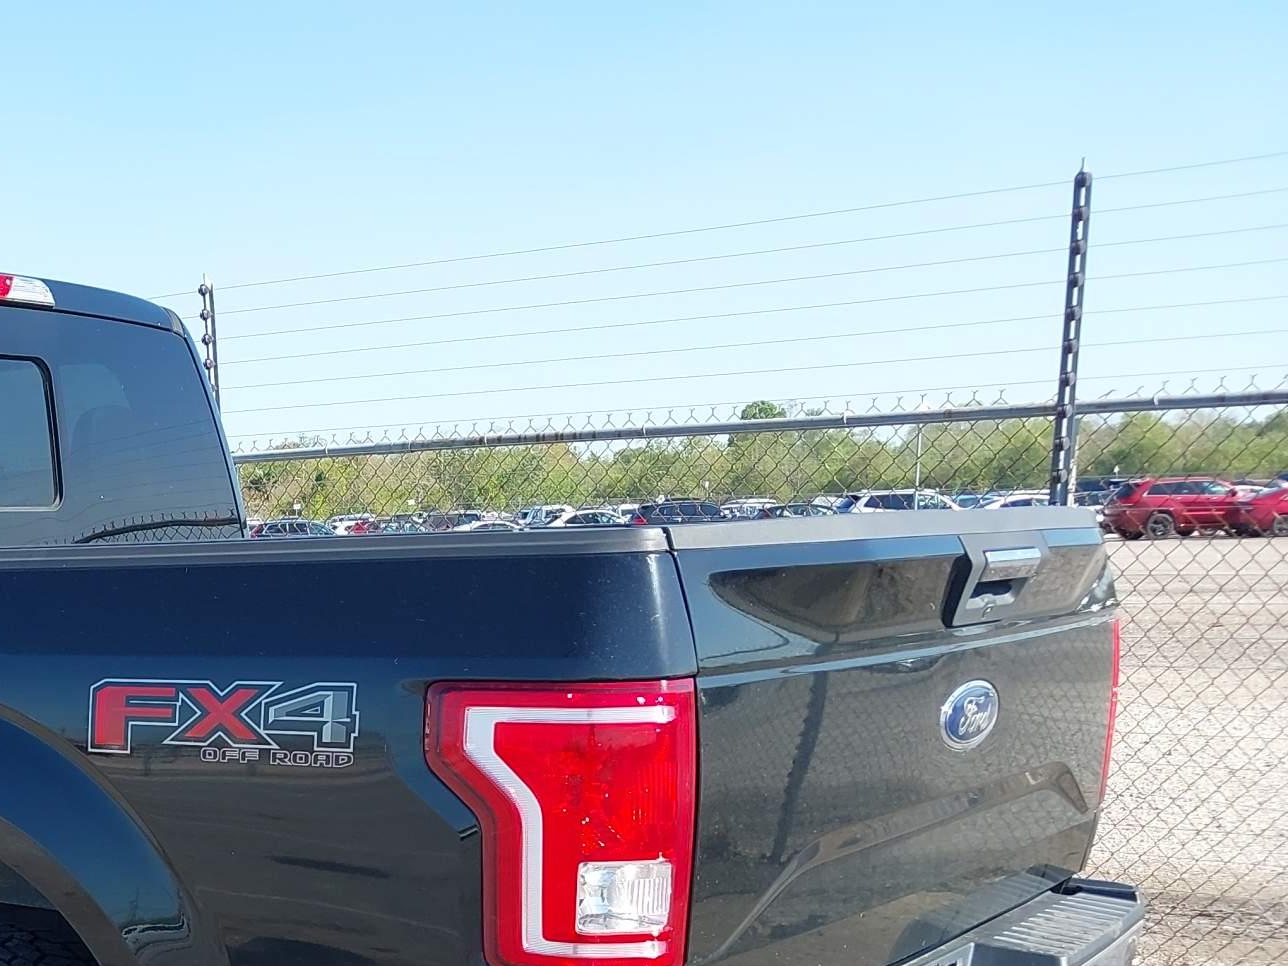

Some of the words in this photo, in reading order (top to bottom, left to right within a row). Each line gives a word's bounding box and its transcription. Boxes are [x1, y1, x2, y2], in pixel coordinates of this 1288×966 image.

[88, 678, 360, 753] FX4
[200, 747, 260, 764] OFF
[270, 750, 354, 768] ROAD
